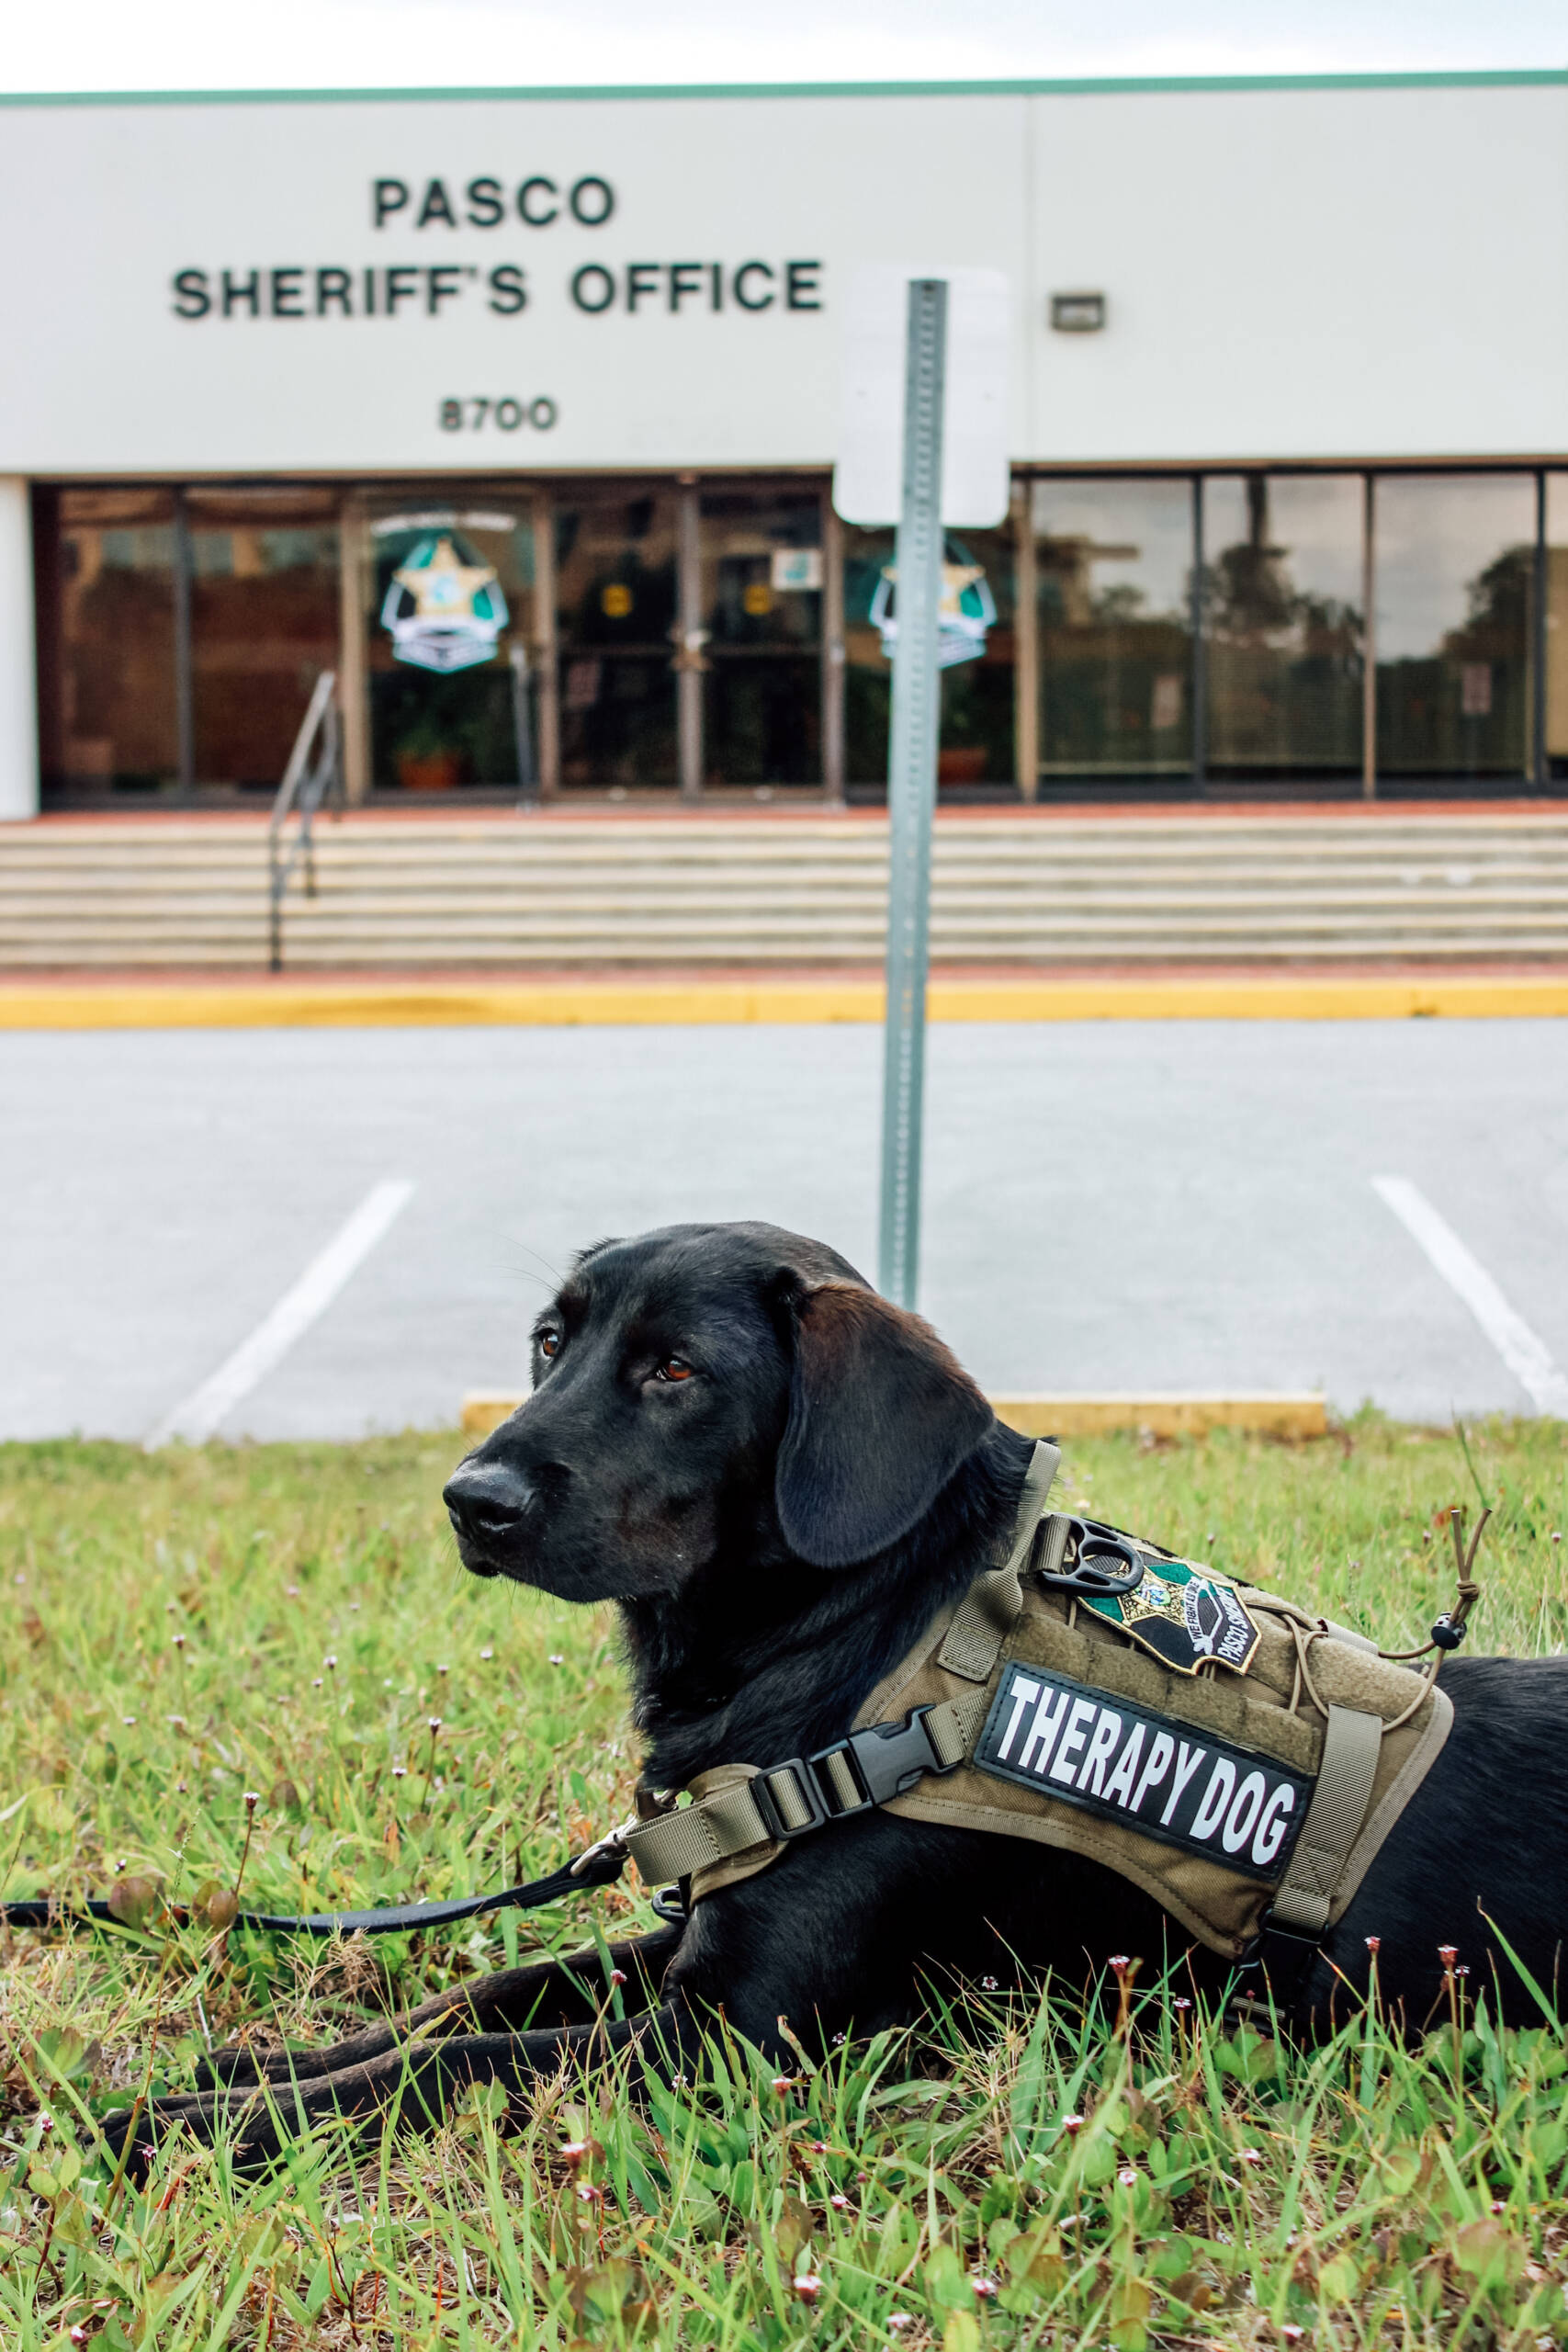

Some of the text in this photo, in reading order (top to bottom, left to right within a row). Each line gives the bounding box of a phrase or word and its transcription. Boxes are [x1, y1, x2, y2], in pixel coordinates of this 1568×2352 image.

[372, 175, 616, 230] PASCO
[172, 262, 824, 318] SHERIFF'S OFFICE
[439, 397, 558, 432] 8700
[1217, 1624, 1248, 1662] PASCO
[998, 1676, 1294, 1865] THERAPY DOG
